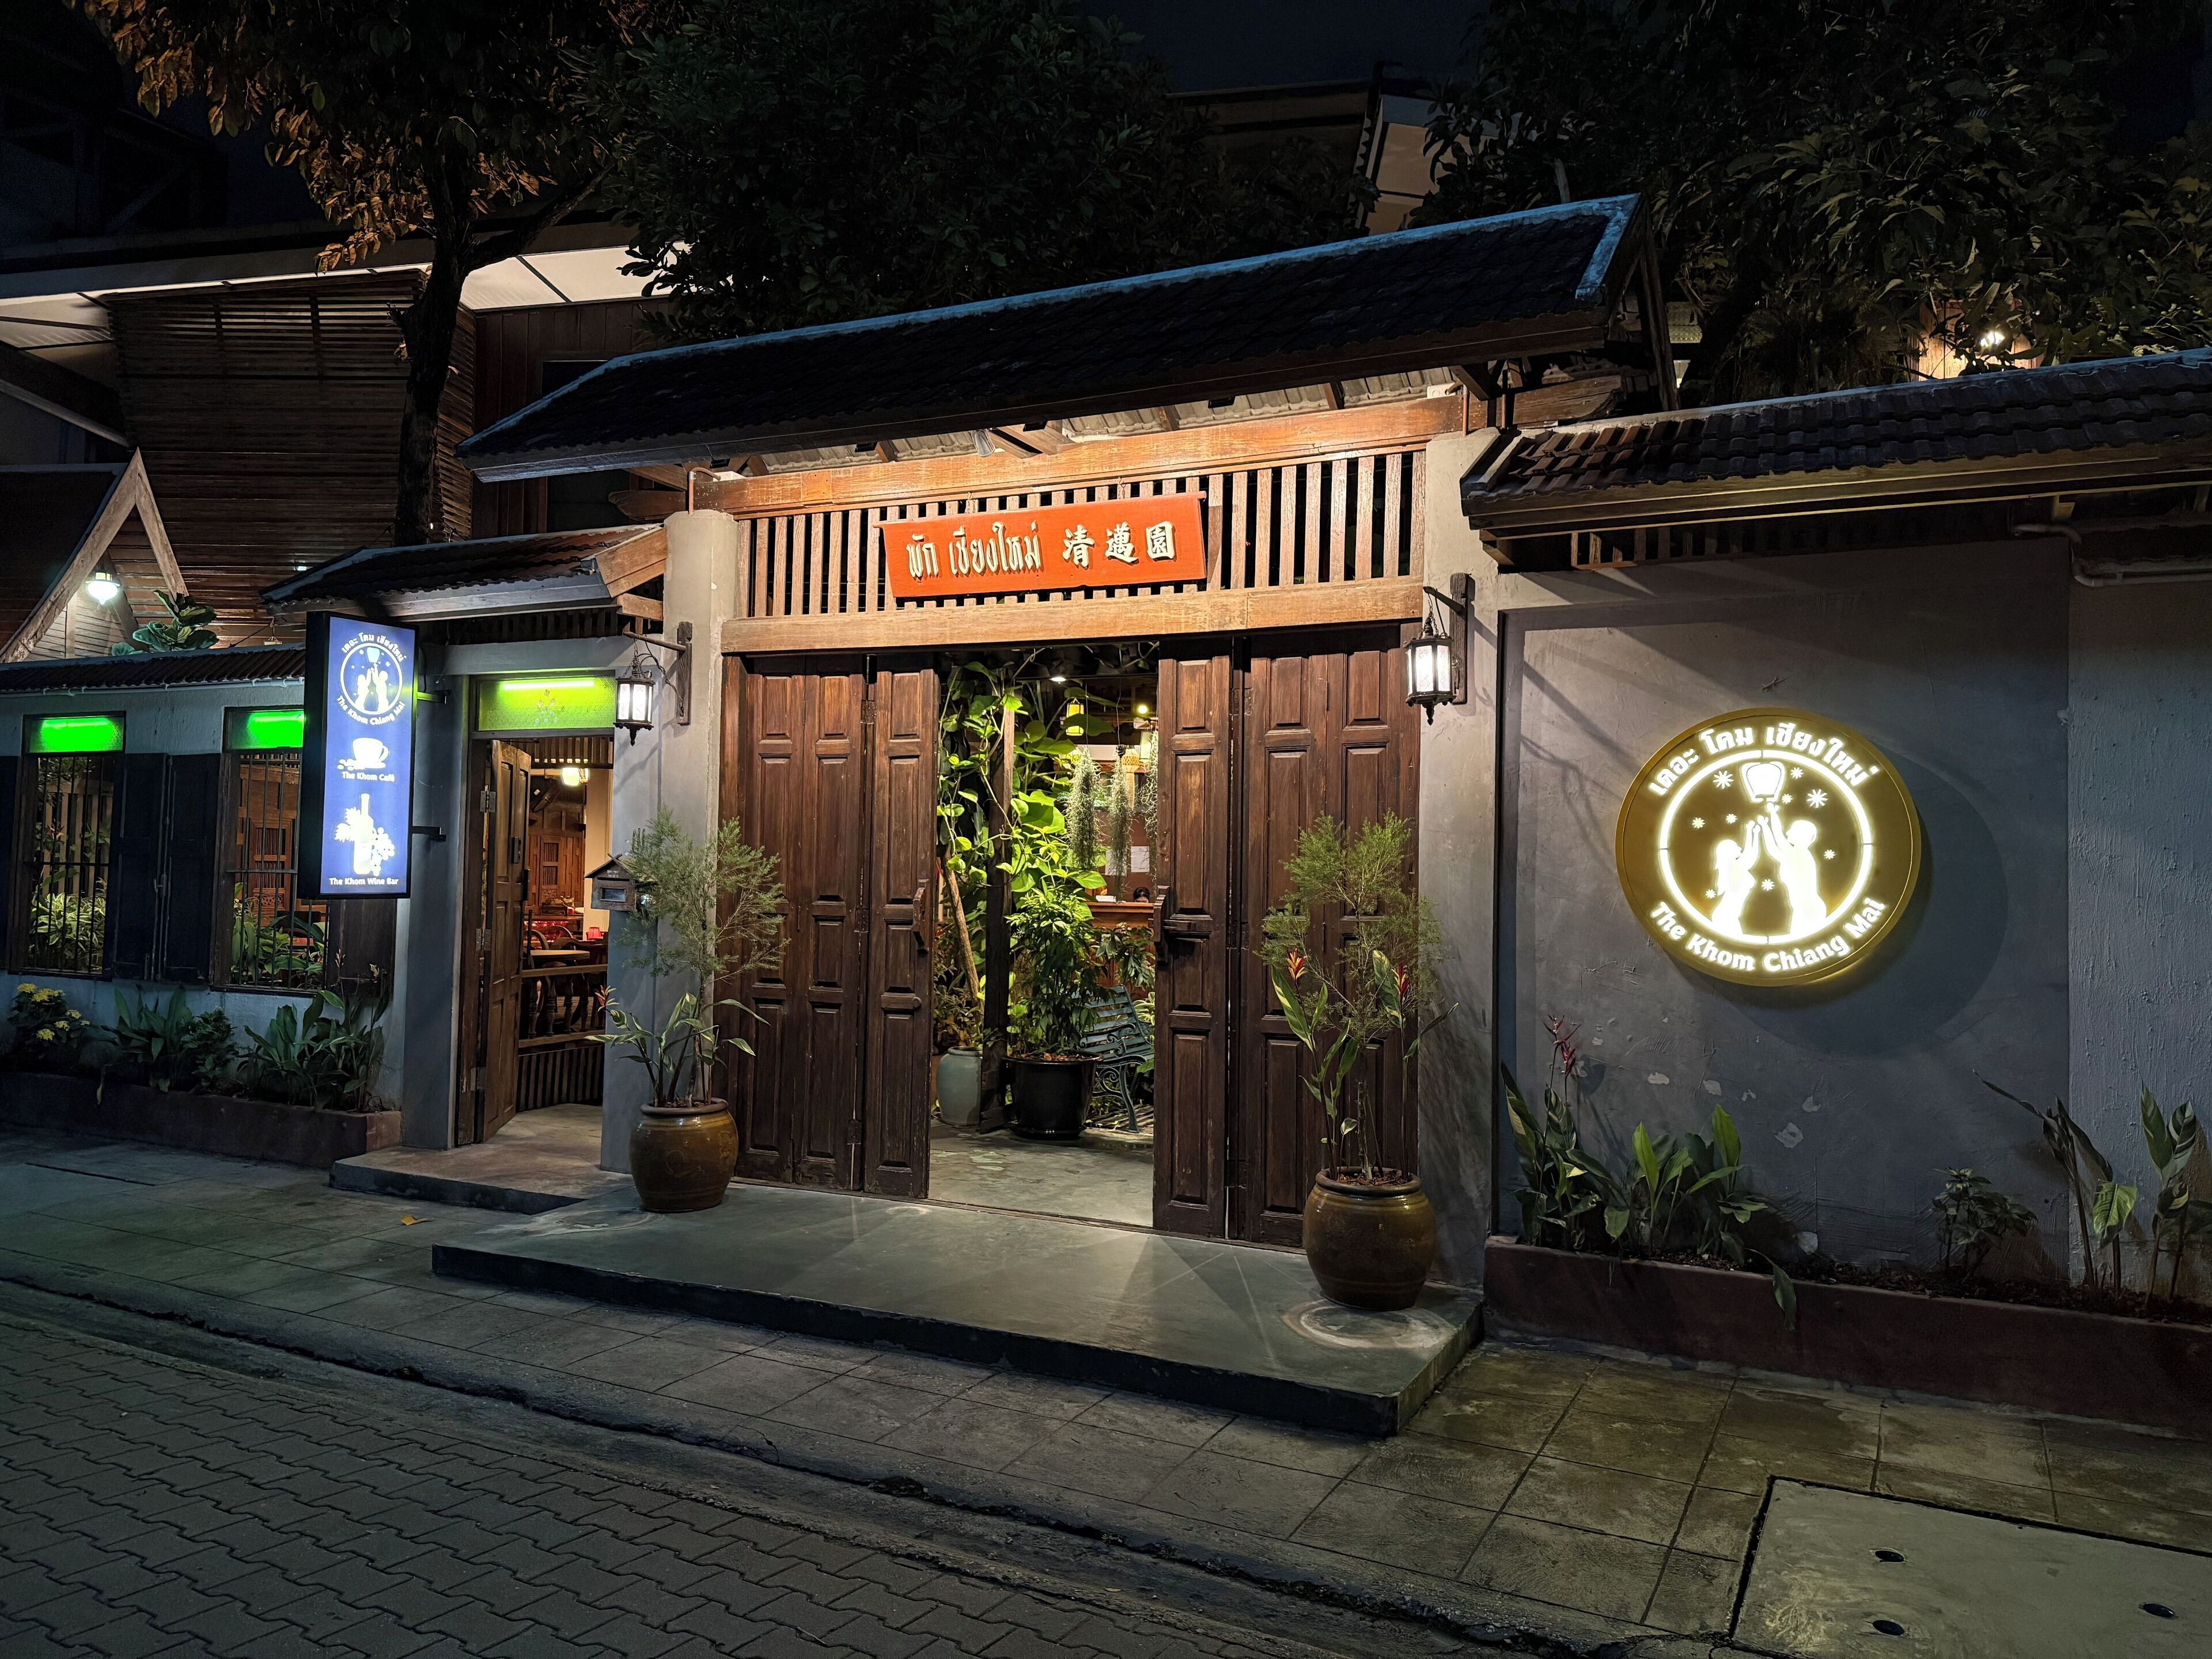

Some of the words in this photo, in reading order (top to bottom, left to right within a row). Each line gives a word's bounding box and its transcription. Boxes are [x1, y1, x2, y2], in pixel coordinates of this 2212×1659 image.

[906, 533, 939, 577] พัก
[949, 520, 1041, 574] เชียงใหม่
[1062, 521, 1175, 568] 清邁園
[337, 695, 349, 711] The
[348, 709, 368, 724] Khom
[370, 713, 395, 725] Chiang
[393, 701, 406, 715] Mai
[342, 771, 355, 779] The
[357, 772, 377, 781] Khom
[1700, 727, 1755, 755] โคม
[1766, 722, 1881, 787] เชียงใหม่
[344, 877, 365, 885] Khom
[1652, 902, 1687, 940] The
[1686, 934, 1756, 971] Khom
[1763, 934, 1850, 972] Chiang
[1843, 897, 1885, 939] Mai
